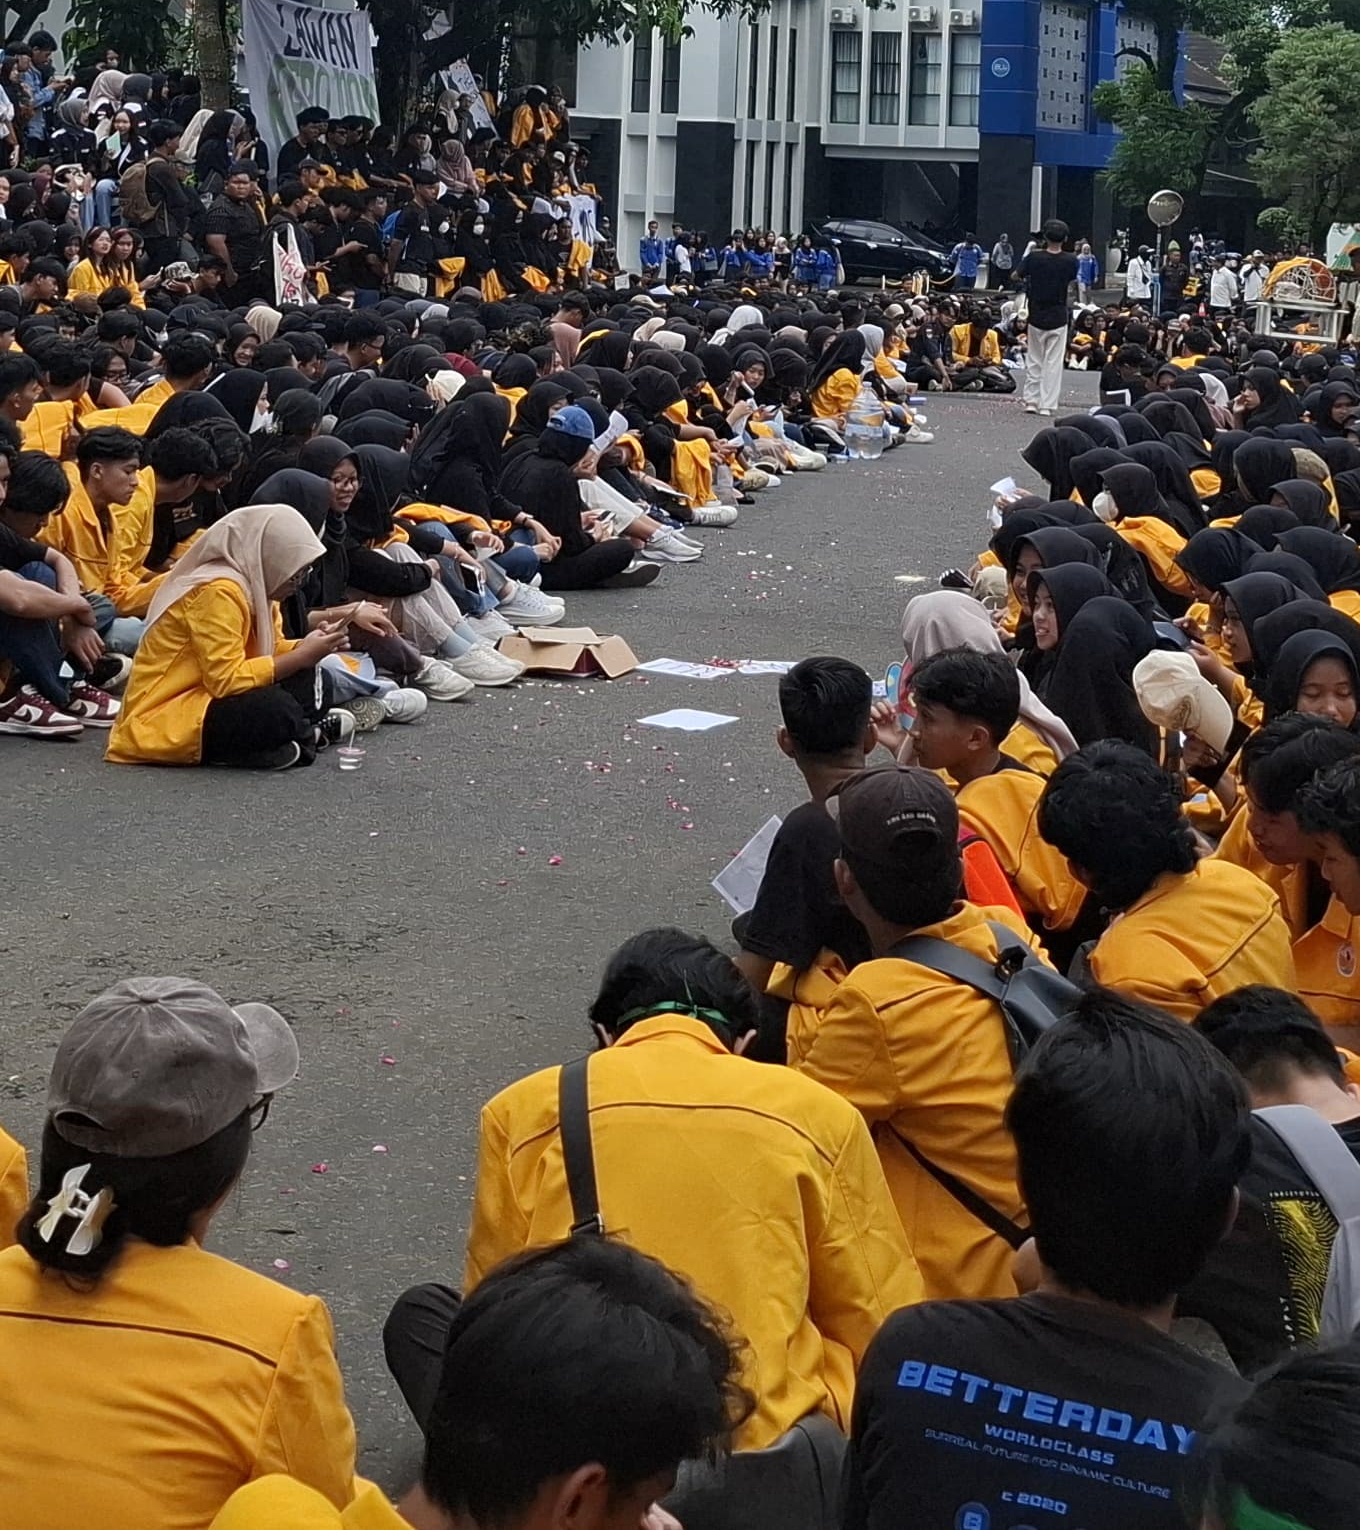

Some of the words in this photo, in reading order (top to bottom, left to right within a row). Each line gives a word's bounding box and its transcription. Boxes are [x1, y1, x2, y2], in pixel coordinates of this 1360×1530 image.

[275, 3, 359, 70] LAWAN
[896, 1359, 1200, 1455] BETTERDAY
[984, 1423, 1116, 1466] WORLDCLASS
[1016, 1491, 1069, 1516] 2020
[1112, 1475, 1171, 1499] CULTURE
